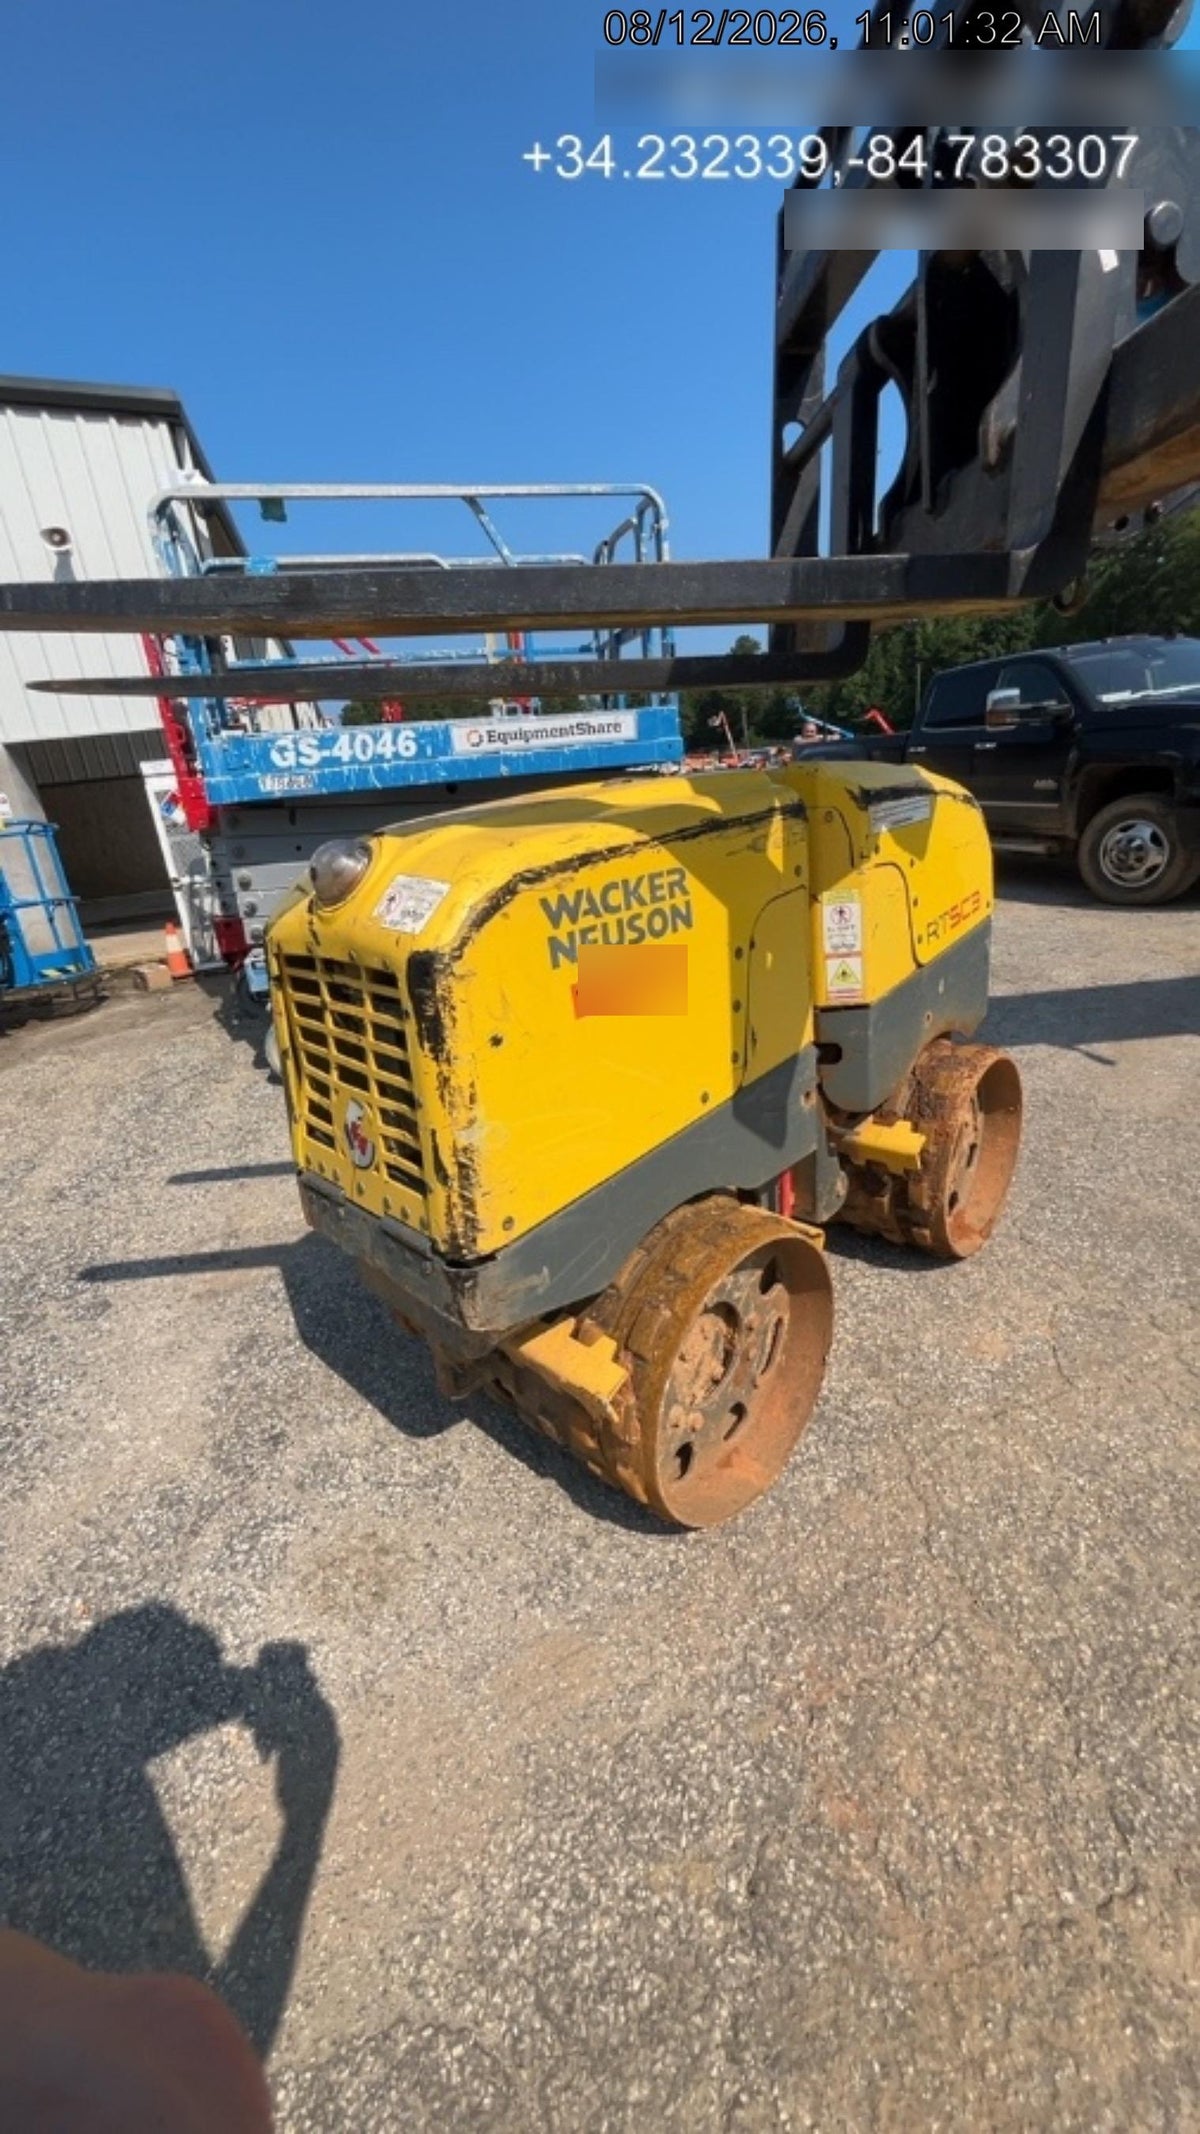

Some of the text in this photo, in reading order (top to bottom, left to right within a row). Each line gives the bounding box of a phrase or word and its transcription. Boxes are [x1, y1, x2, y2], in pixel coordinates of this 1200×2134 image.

[270, 729, 418, 768] GS-4046
[487, 722, 622, 745] EquipmentShare
[539, 867, 690, 930] WACKER
